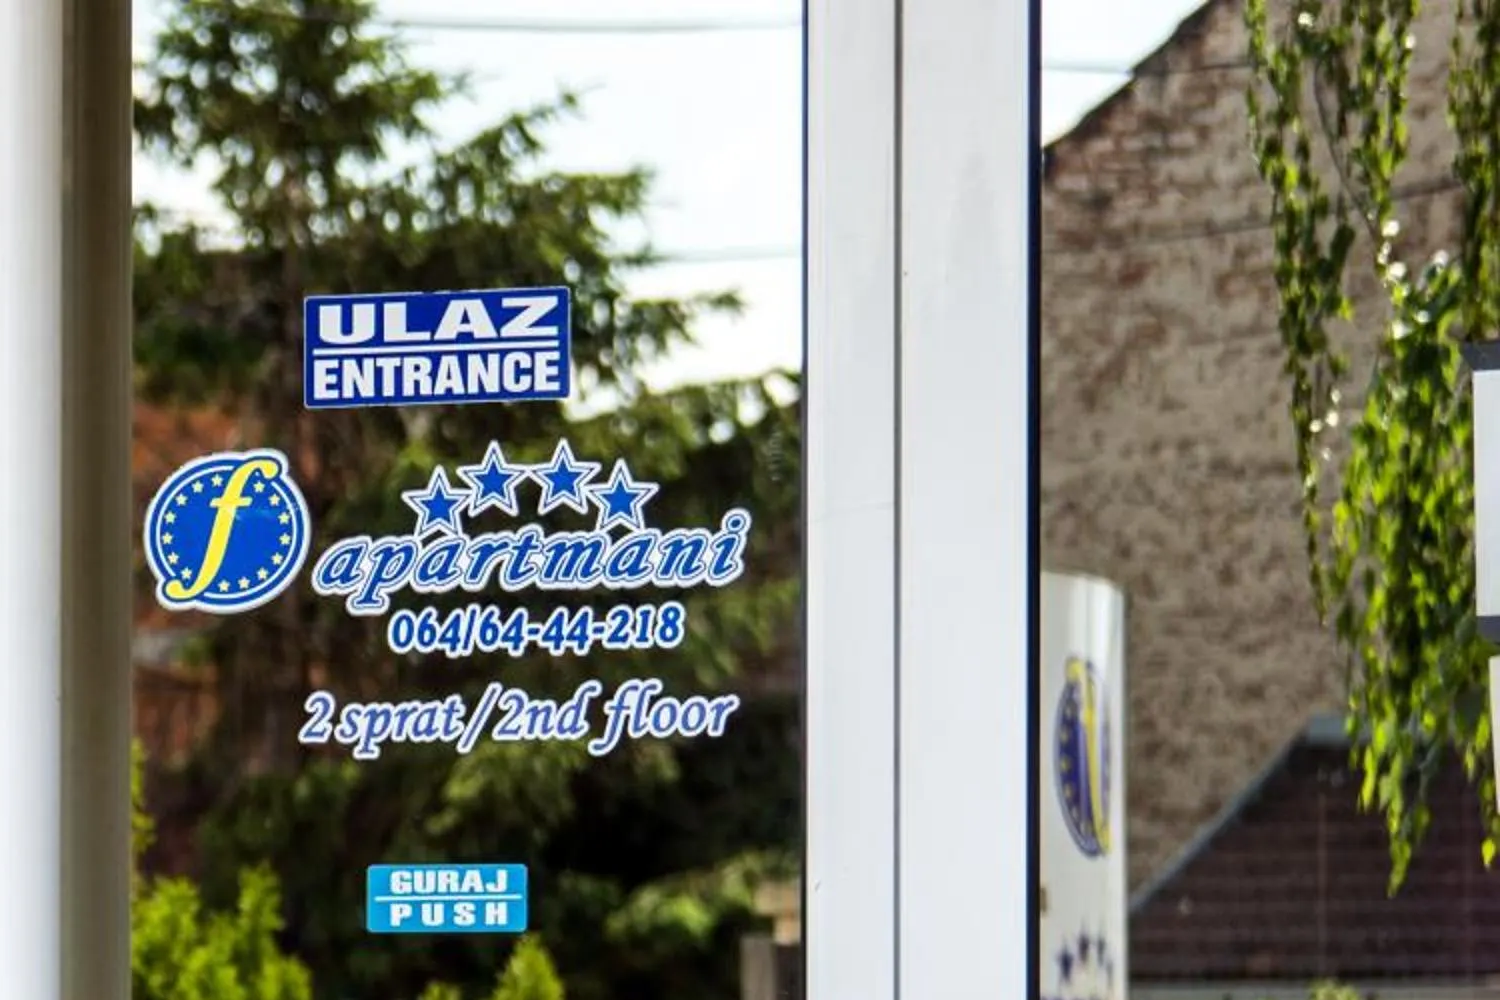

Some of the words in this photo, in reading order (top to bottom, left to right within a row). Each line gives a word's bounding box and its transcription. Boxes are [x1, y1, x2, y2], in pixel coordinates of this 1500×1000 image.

[318, 296, 559, 343] ULAZ
[313, 351, 560, 399] ENTRANCE
[317, 512, 749, 612] apartmani
[389, 594, 684, 655] 064/64-44-218
[589, 678, 740, 755] floor
[390, 869, 508, 894] GURAJ
[390, 901, 508, 927] PUSH
